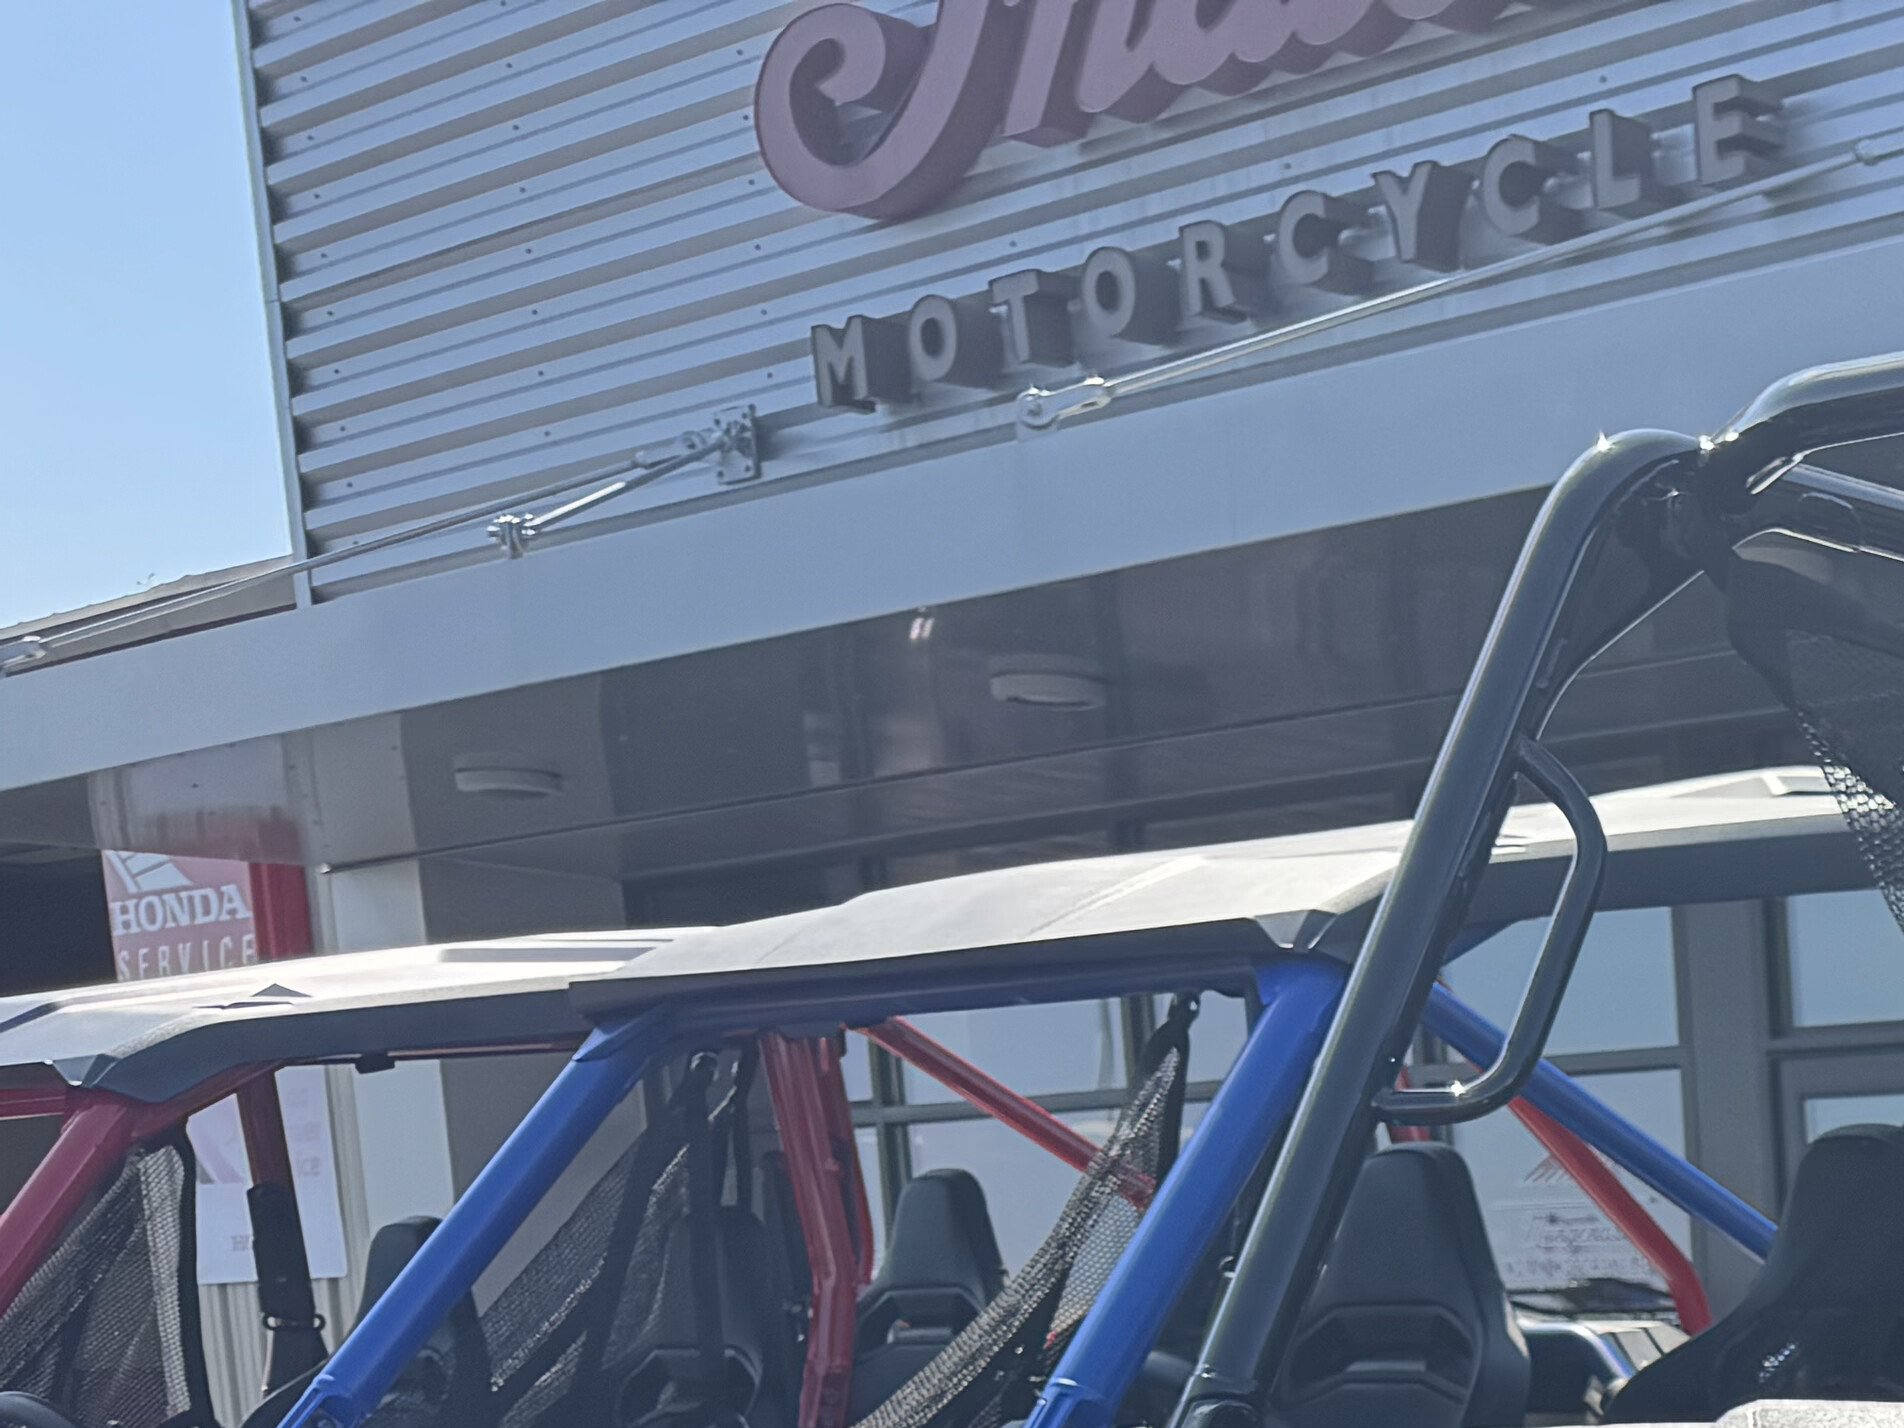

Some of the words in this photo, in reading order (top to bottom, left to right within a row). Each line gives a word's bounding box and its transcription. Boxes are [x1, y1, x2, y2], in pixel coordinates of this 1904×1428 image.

[812, 72, 1785, 411] MOTORCYCLE
[111, 885, 251, 935] HONDA
[118, 935, 257, 982] SERVICE
